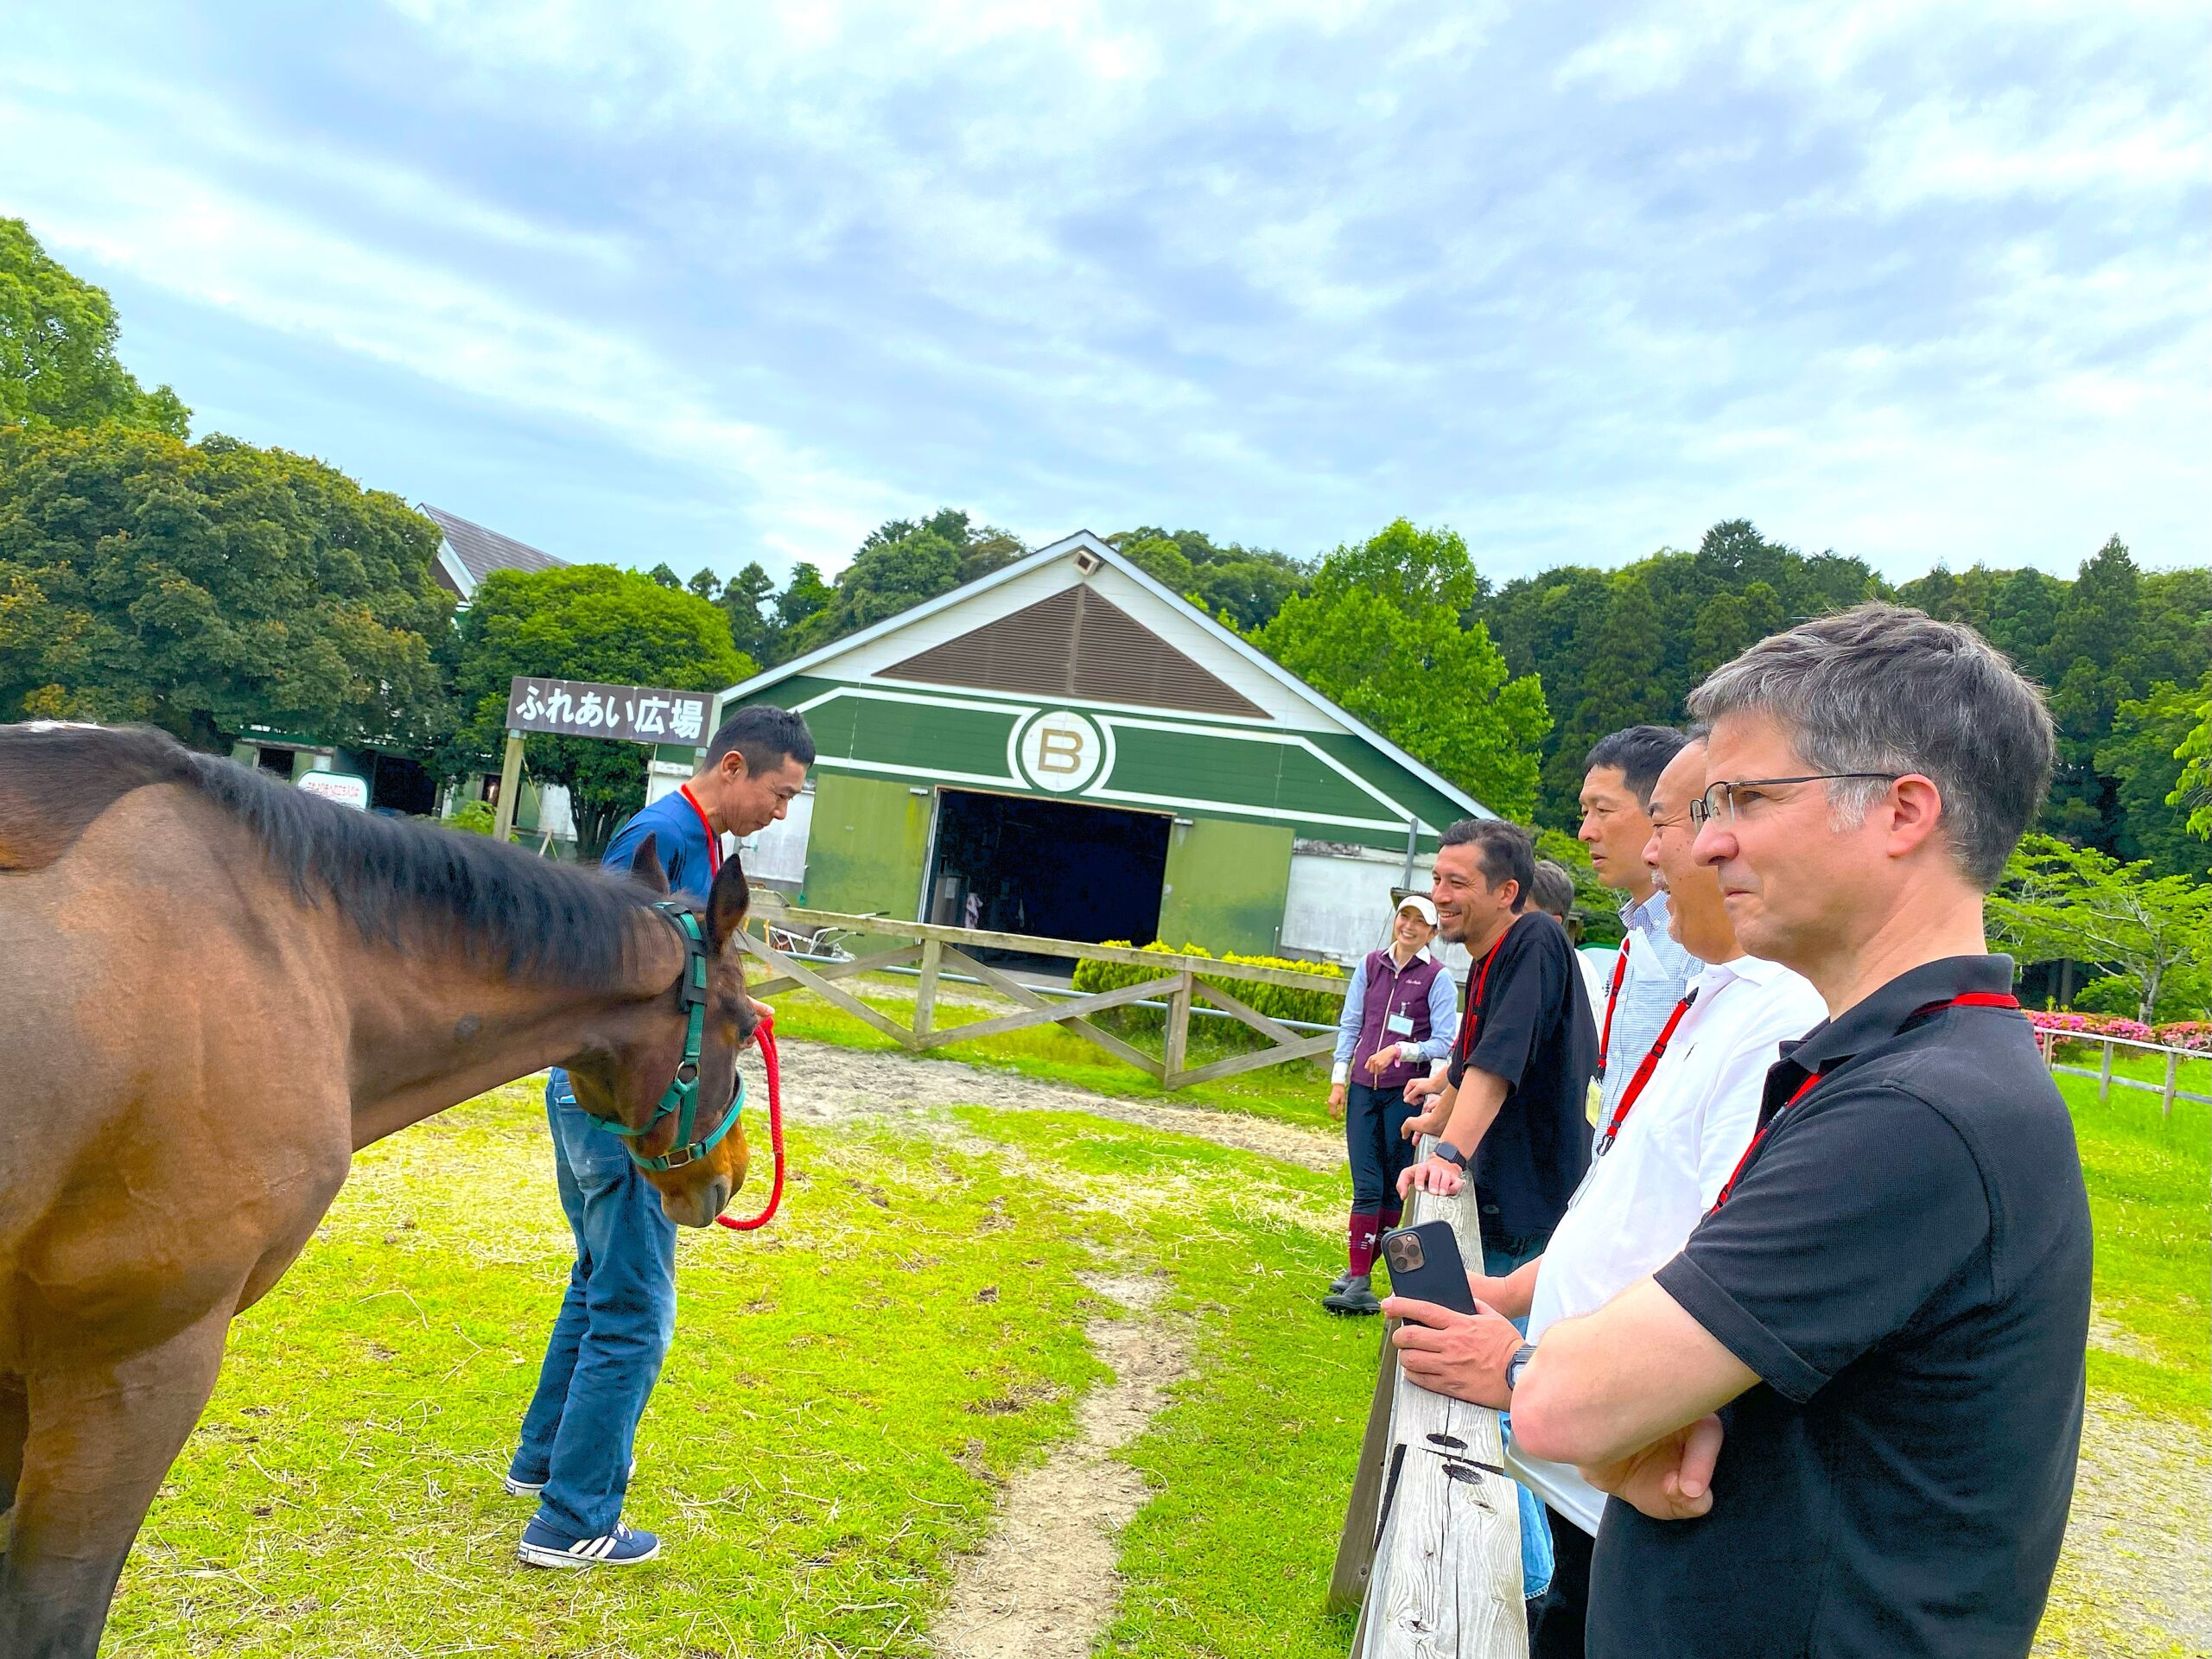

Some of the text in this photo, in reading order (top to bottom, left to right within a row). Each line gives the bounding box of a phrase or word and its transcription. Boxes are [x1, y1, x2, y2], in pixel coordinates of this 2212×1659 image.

[516, 686, 702, 739] ふれあい広場
[1038, 728, 1083, 774] B
